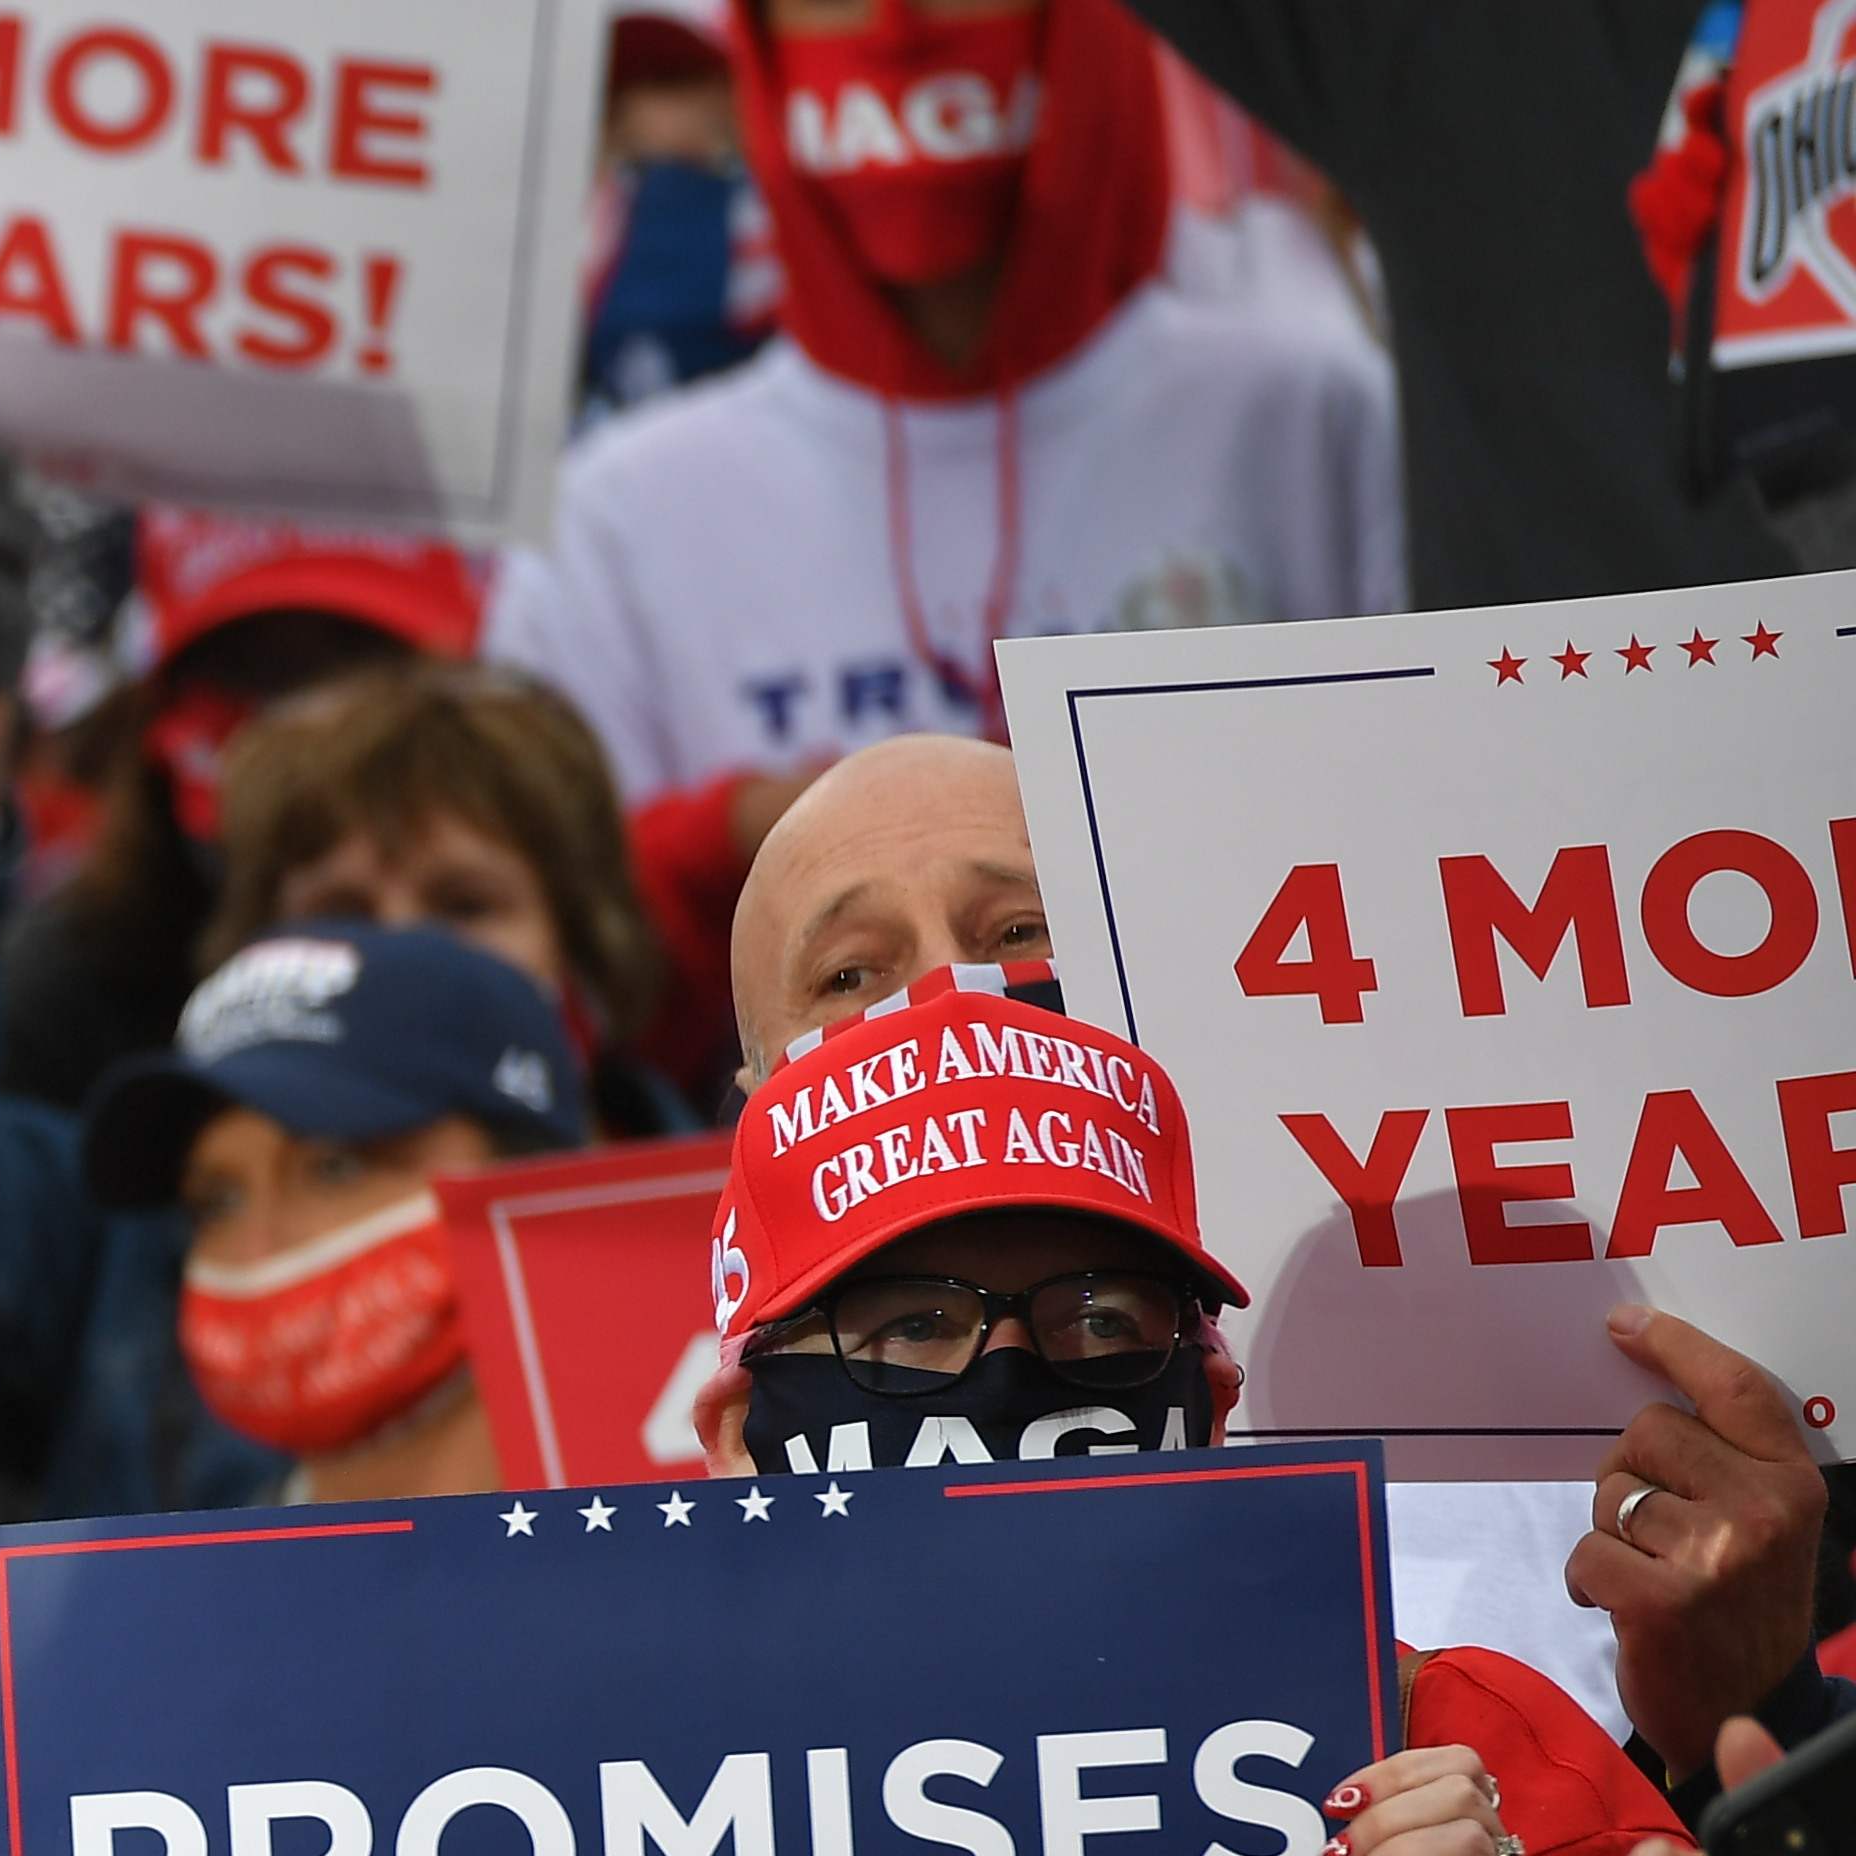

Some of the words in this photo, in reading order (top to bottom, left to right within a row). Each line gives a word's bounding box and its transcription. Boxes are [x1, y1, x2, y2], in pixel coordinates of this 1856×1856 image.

[1233, 861, 1380, 1028] 4
[1438, 814, 1856, 1018] MO
[766, 1039, 926, 1159] MAKE
[935, 1022, 1162, 1137] AMERICA
[810, 1106, 988, 1224] GREAT
[1003, 1106, 1155, 1205] AGAIN
